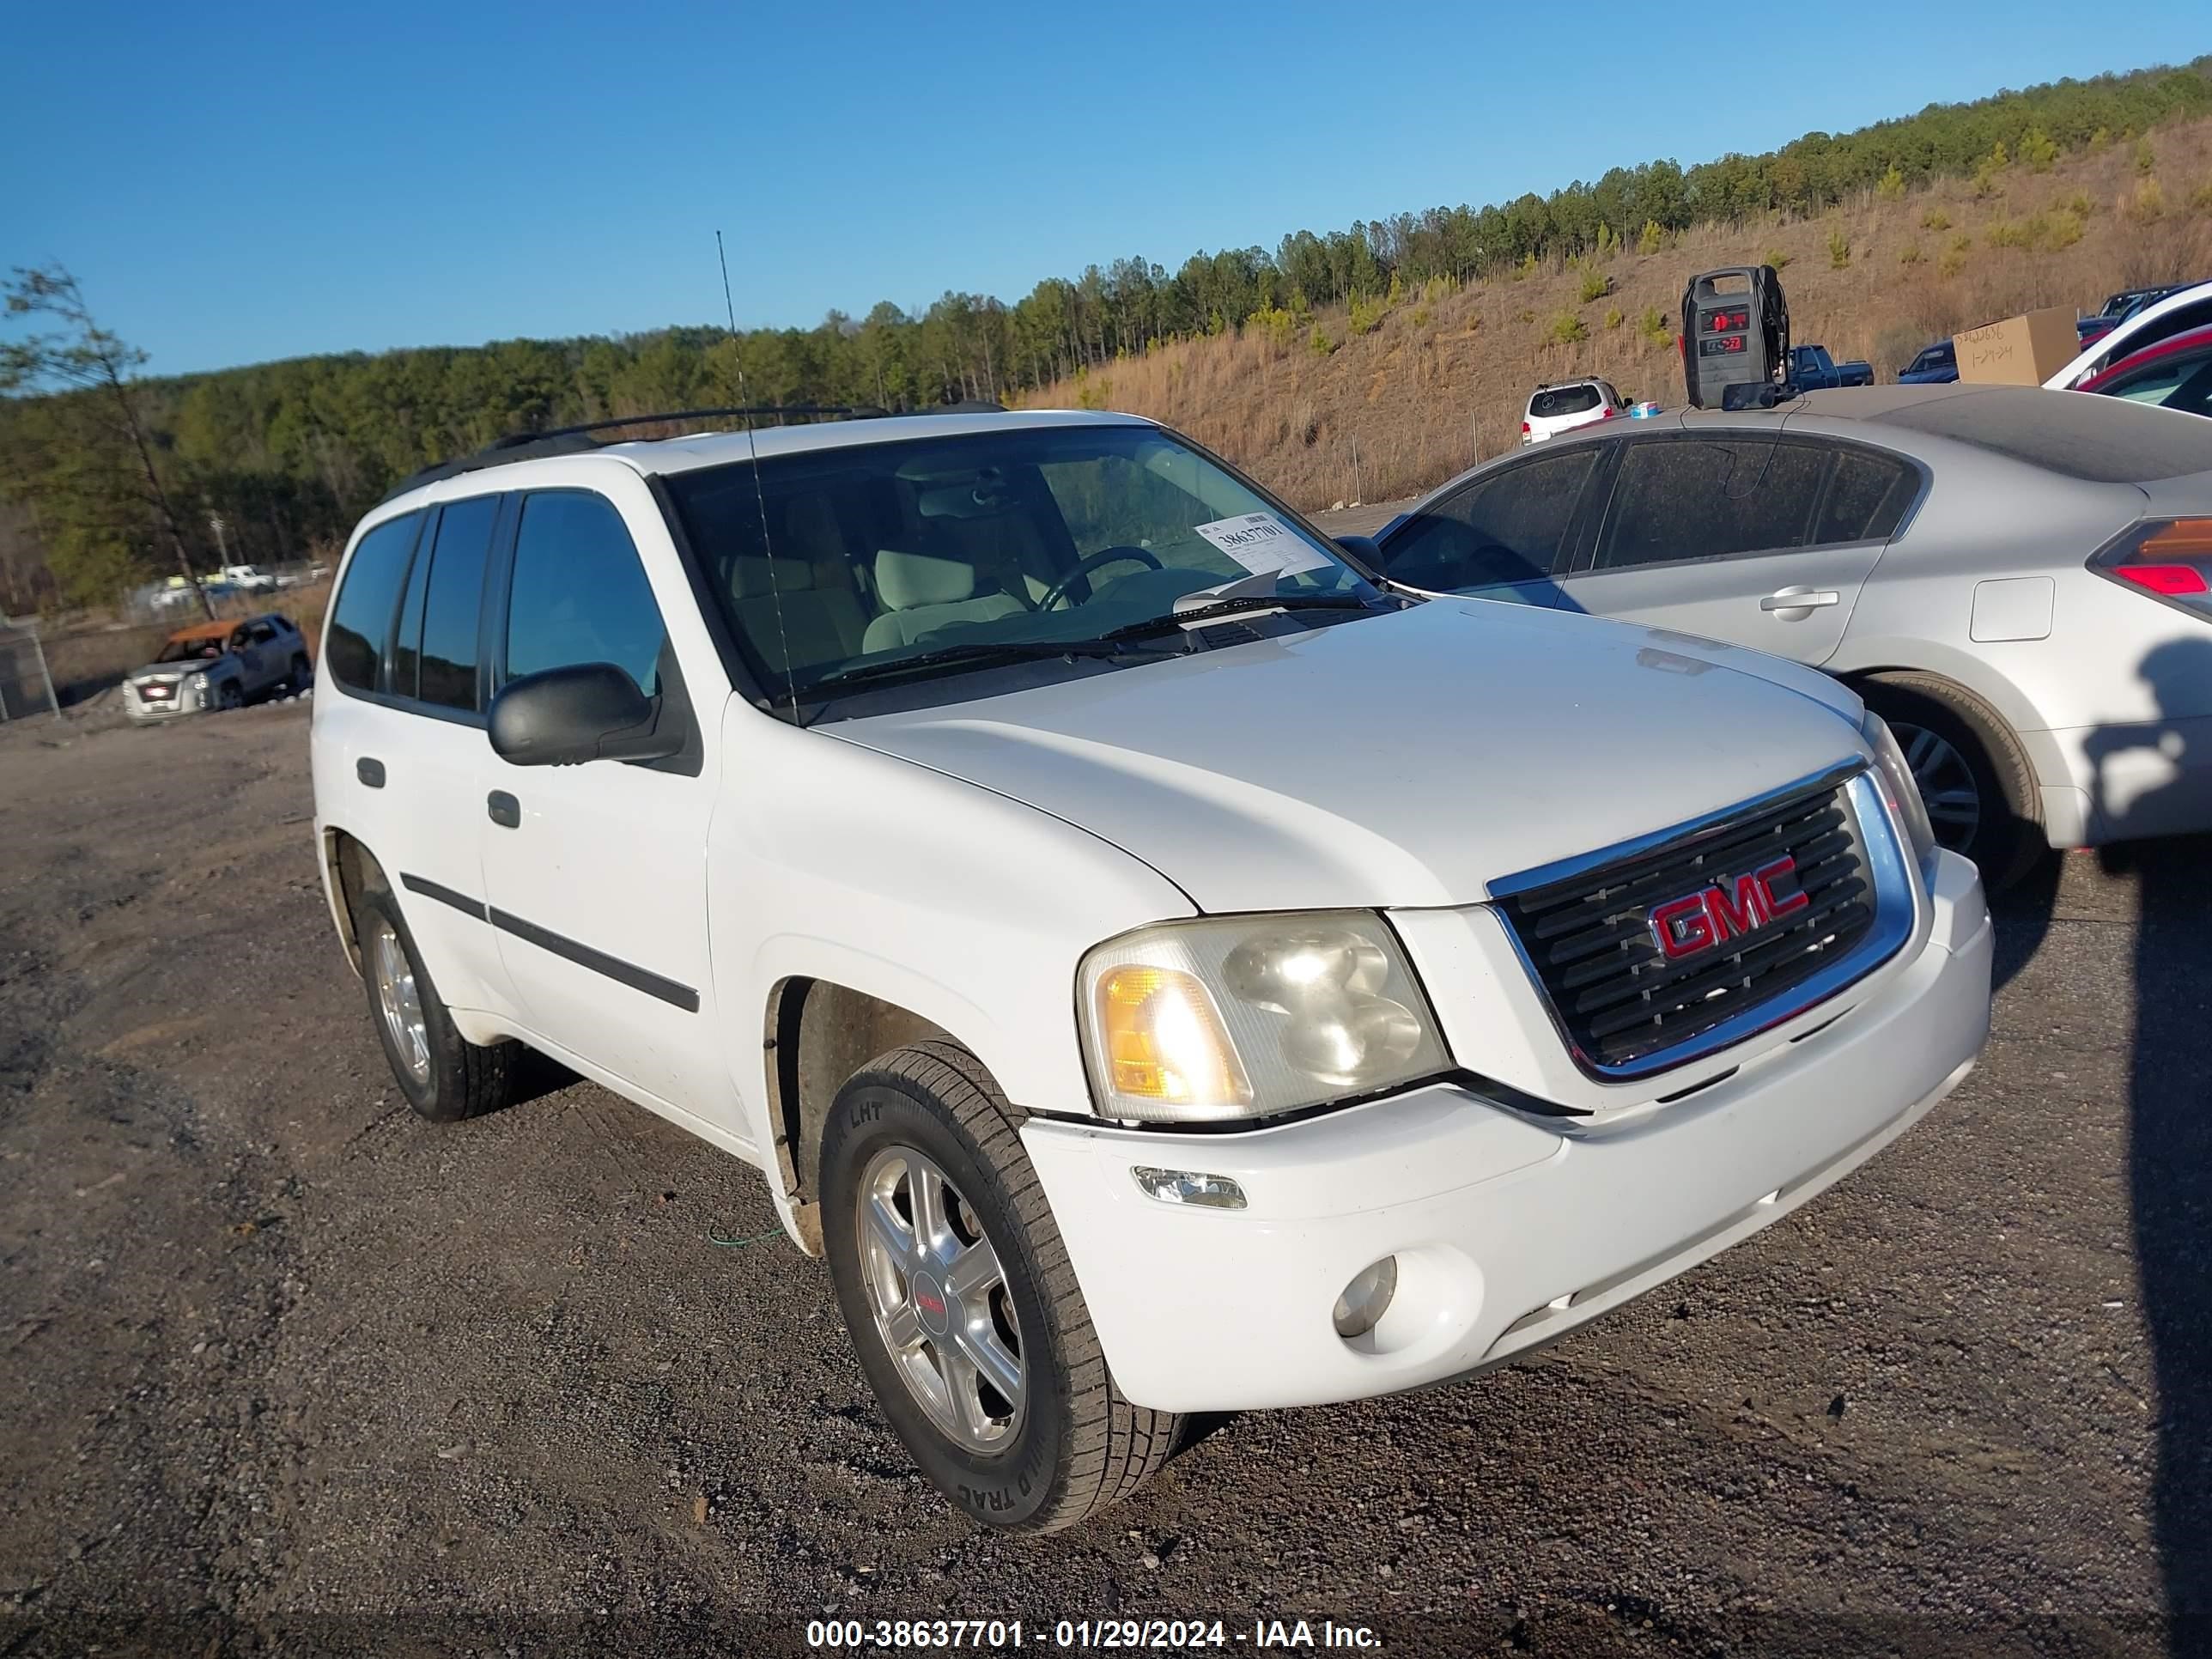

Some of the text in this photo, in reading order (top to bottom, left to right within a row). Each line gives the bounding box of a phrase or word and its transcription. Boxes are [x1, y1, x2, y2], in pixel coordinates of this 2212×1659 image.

[1218, 524, 1284, 548] 38637701
[1647, 854, 1810, 961] GMC
[850, 1101, 884, 1129] LHT
[957, 1483, 1017, 1511] TRAC
